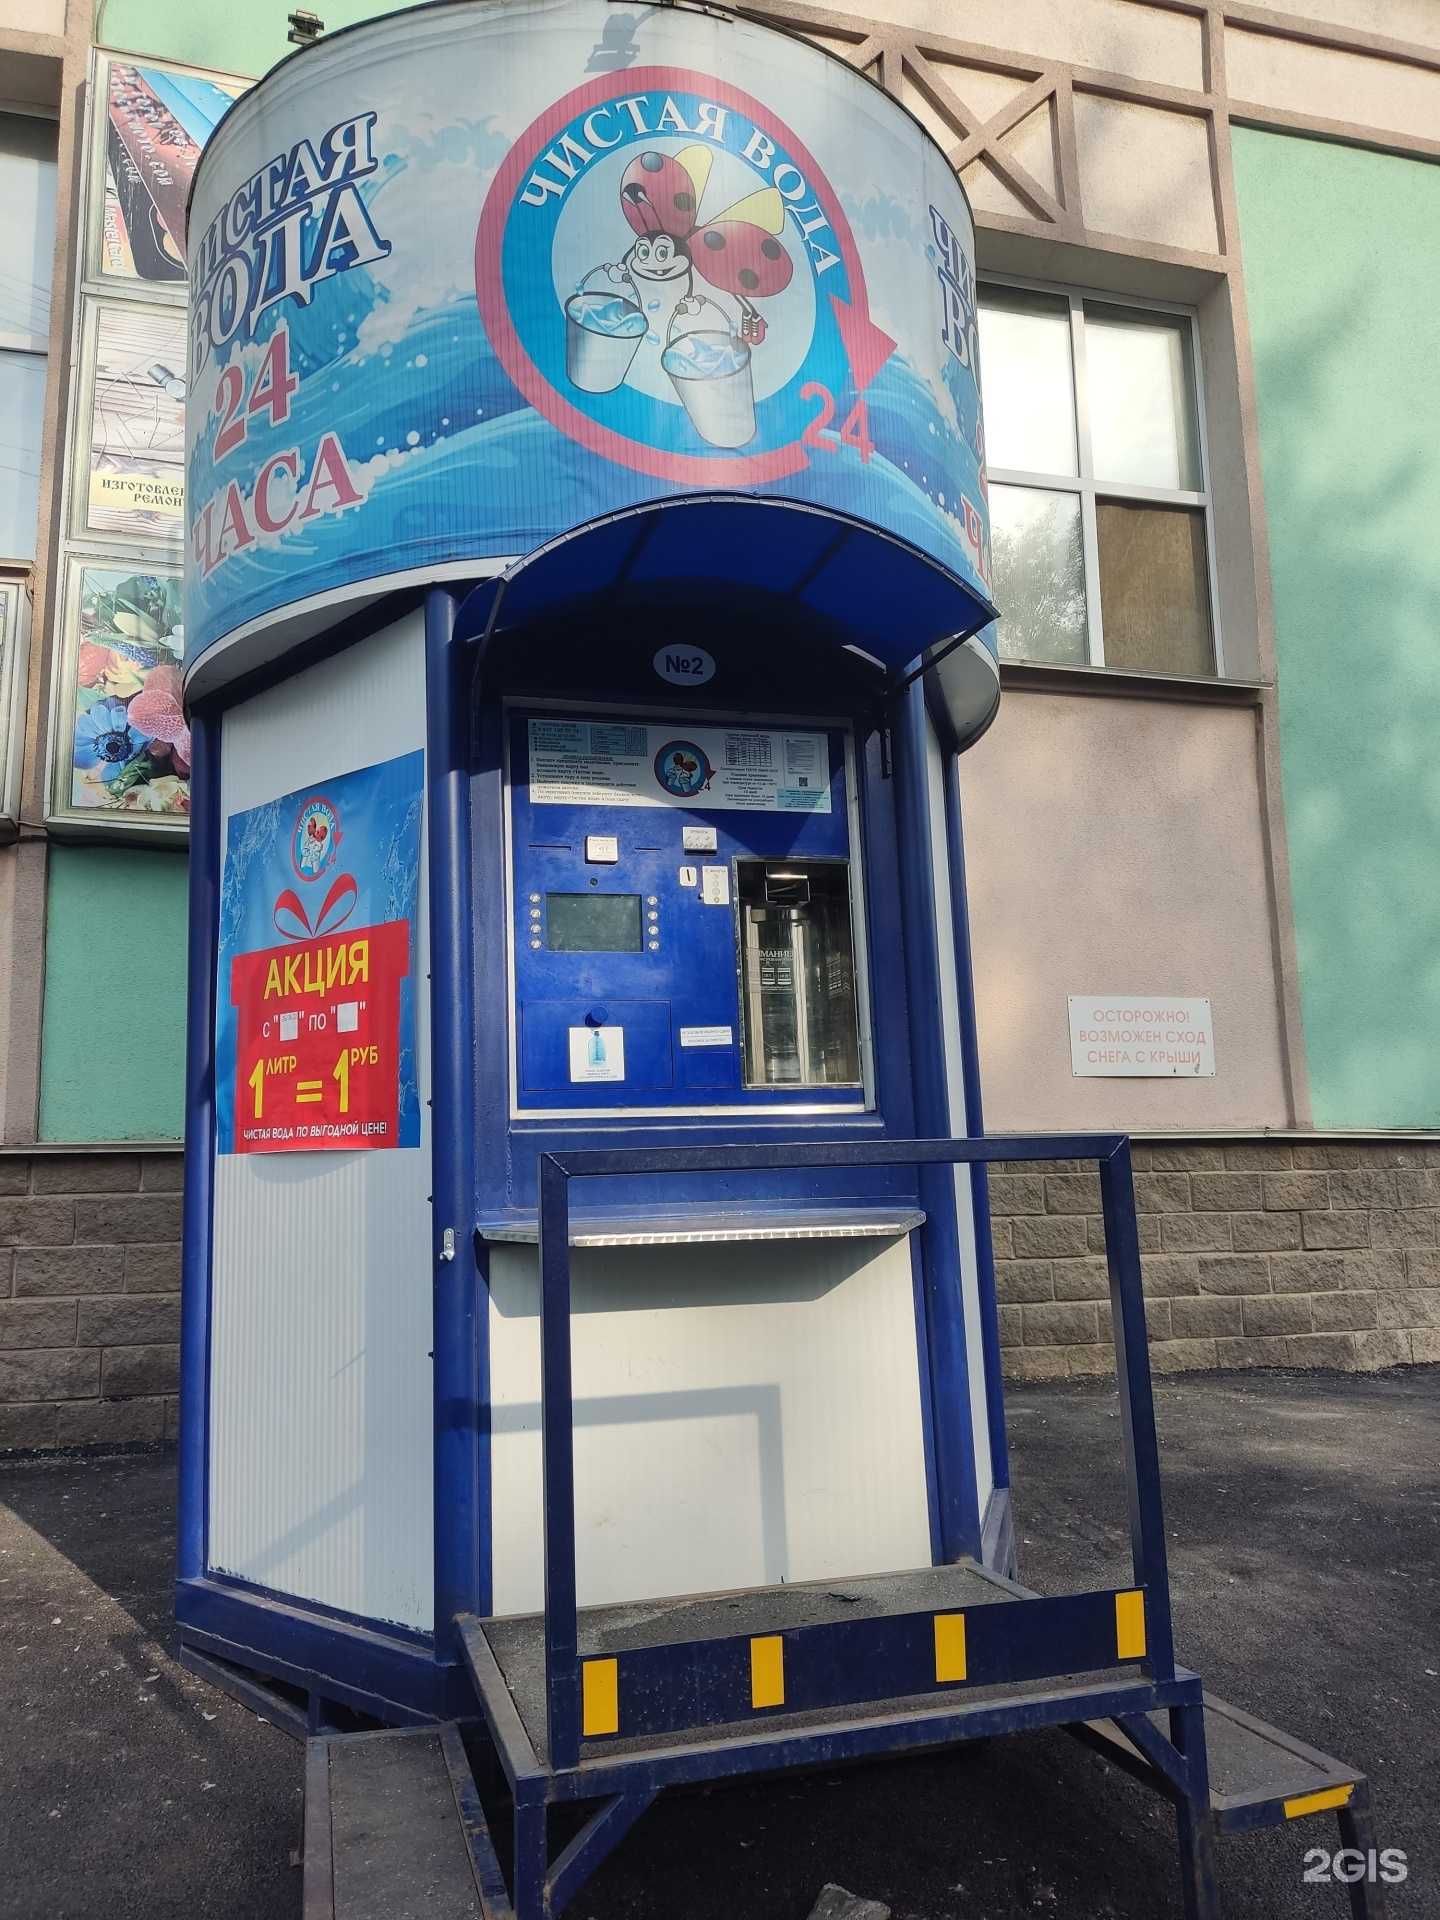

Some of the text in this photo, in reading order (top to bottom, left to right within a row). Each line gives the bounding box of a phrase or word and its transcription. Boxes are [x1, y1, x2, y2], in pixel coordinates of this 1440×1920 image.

[520, 95, 841, 278] ЧИСТАЯ ВОДА
[190, 182, 392, 398] ВОДА
[214, 329, 297, 462] 24
[799, 381, 875, 464] 24
[134, 493, 184, 507] РЕМОН
[192, 436, 364, 577] ЧАСА
[665, 655, 704, 675] №2
[264, 940, 369, 1000] АКЦИЯ
[308, 1013, 326, 1031] ПО
[1093, 1010, 1190, 1024] ОСТОРОЖНО!
[1079, 1030, 1206, 1045] ВОЗМОЖЕН СХОД
[1087, 1050, 1201, 1064] СНЕГА С КРЫШИ
[249, 1059, 264, 1119] 1
[266, 1056, 297, 1075] ЛИТР
[333, 1049, 348, 1113] 1
[351, 1046, 378, 1066] РУБ
[243, 1121, 387, 1140] ЧИСТАЯ ВОДА ПО ВЫГОДНОЙ ЦЕНЕ!
